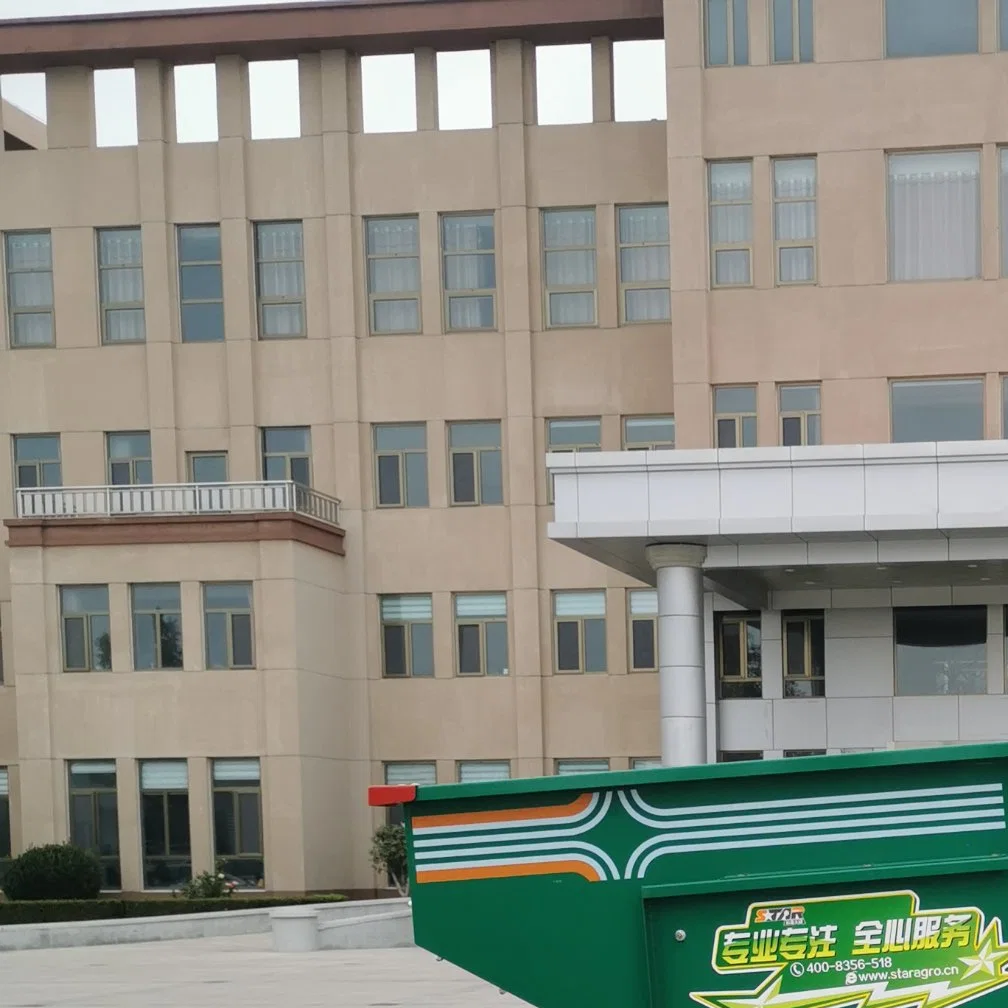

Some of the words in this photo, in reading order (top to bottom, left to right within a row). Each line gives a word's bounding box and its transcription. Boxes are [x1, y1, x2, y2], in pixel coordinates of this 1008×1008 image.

[722, 925, 838, 964] 专业专注
[852, 914, 972, 955] 全心服务
[806, 957, 892, 974] 400-8356-518
[858, 966, 959, 982] www.staragro.cn
